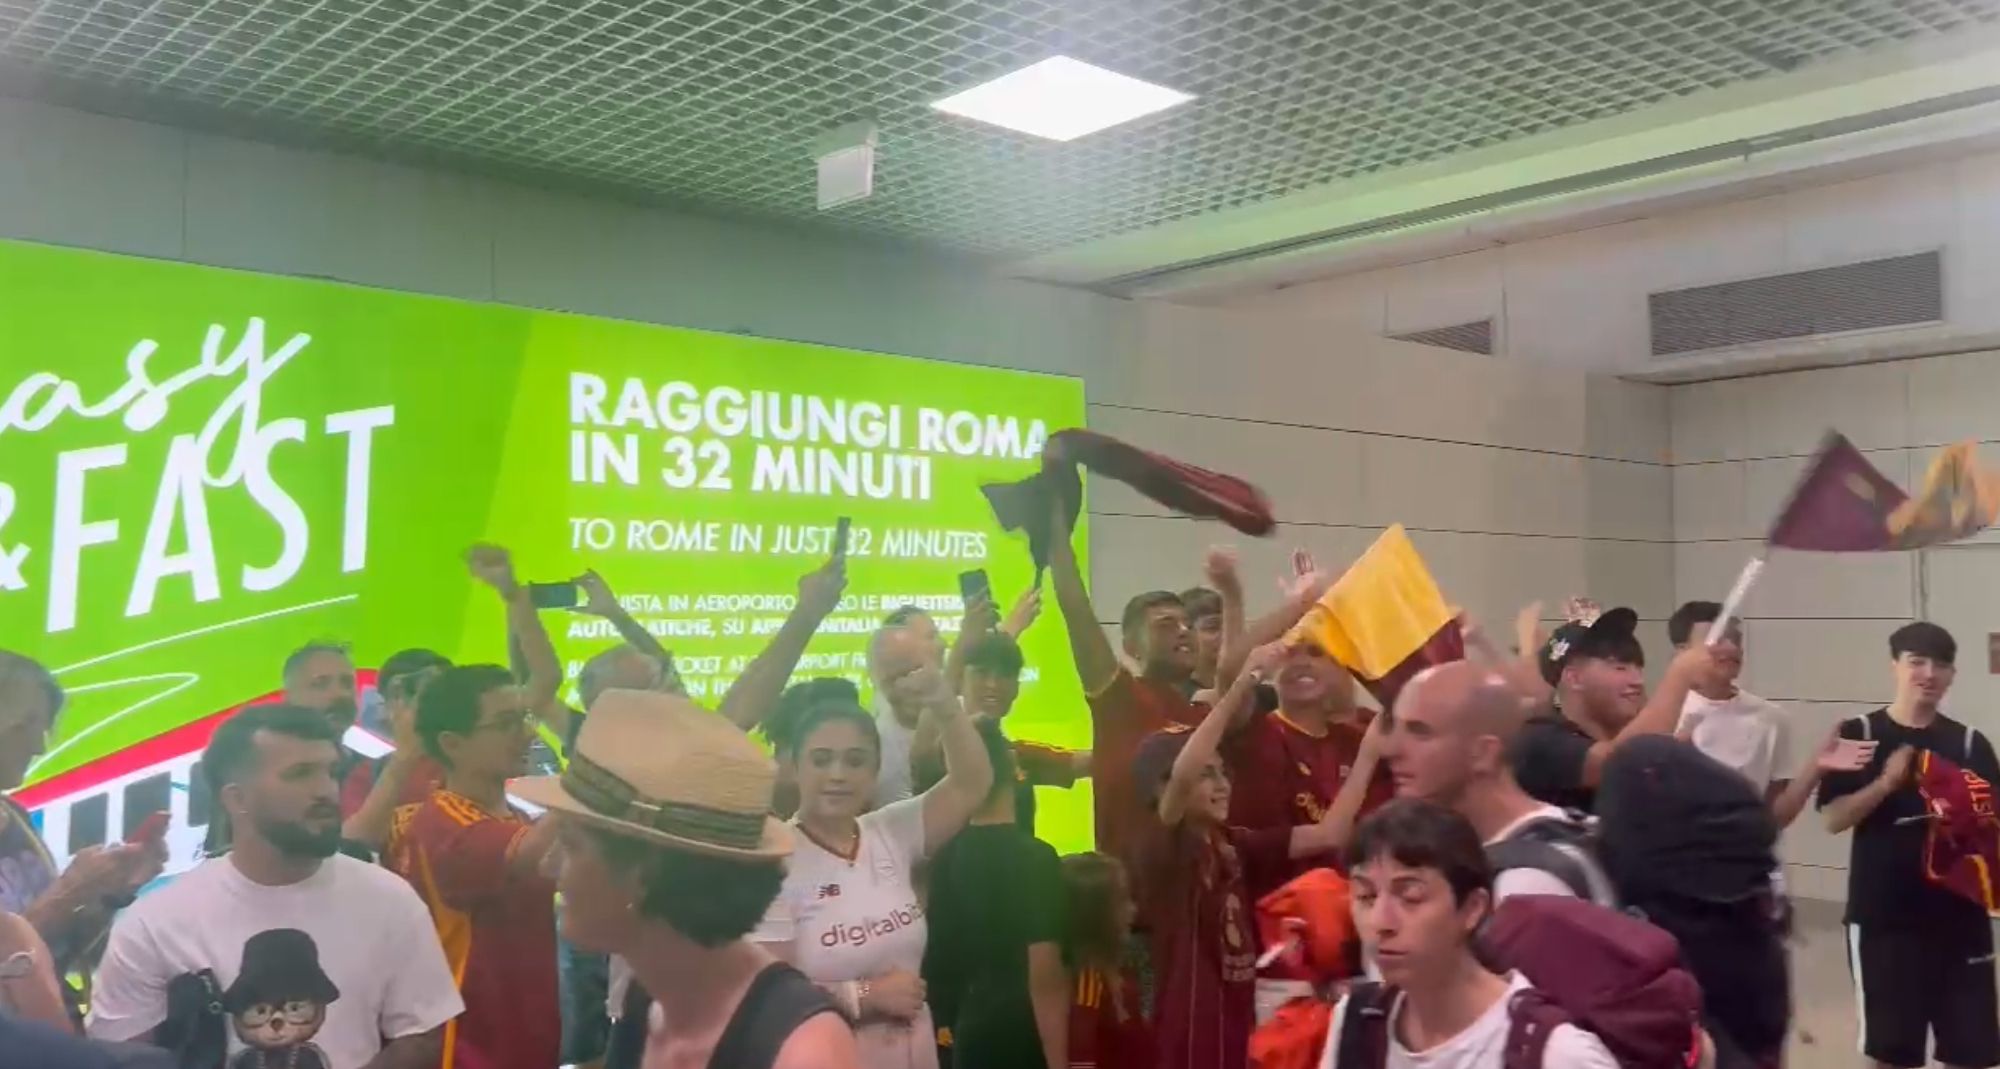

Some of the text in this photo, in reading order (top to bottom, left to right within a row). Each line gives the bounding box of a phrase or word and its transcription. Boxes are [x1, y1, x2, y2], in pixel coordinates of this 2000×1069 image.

[0, 316, 311, 487] asy
[569, 371, 1047, 459] RAGGIUNGI ROMA
[571, 430, 931, 500] IN 32 MINUTI
[47, 404, 395, 633] FAST
[569, 518, 616, 551] TO
[626, 519, 721, 552] ROME
[730, 523, 763, 553] IN
[770, 524, 837, 555] JUST
[881, 528, 988, 559] MINUTES
[694, 594, 797, 612] AEROPORTO
